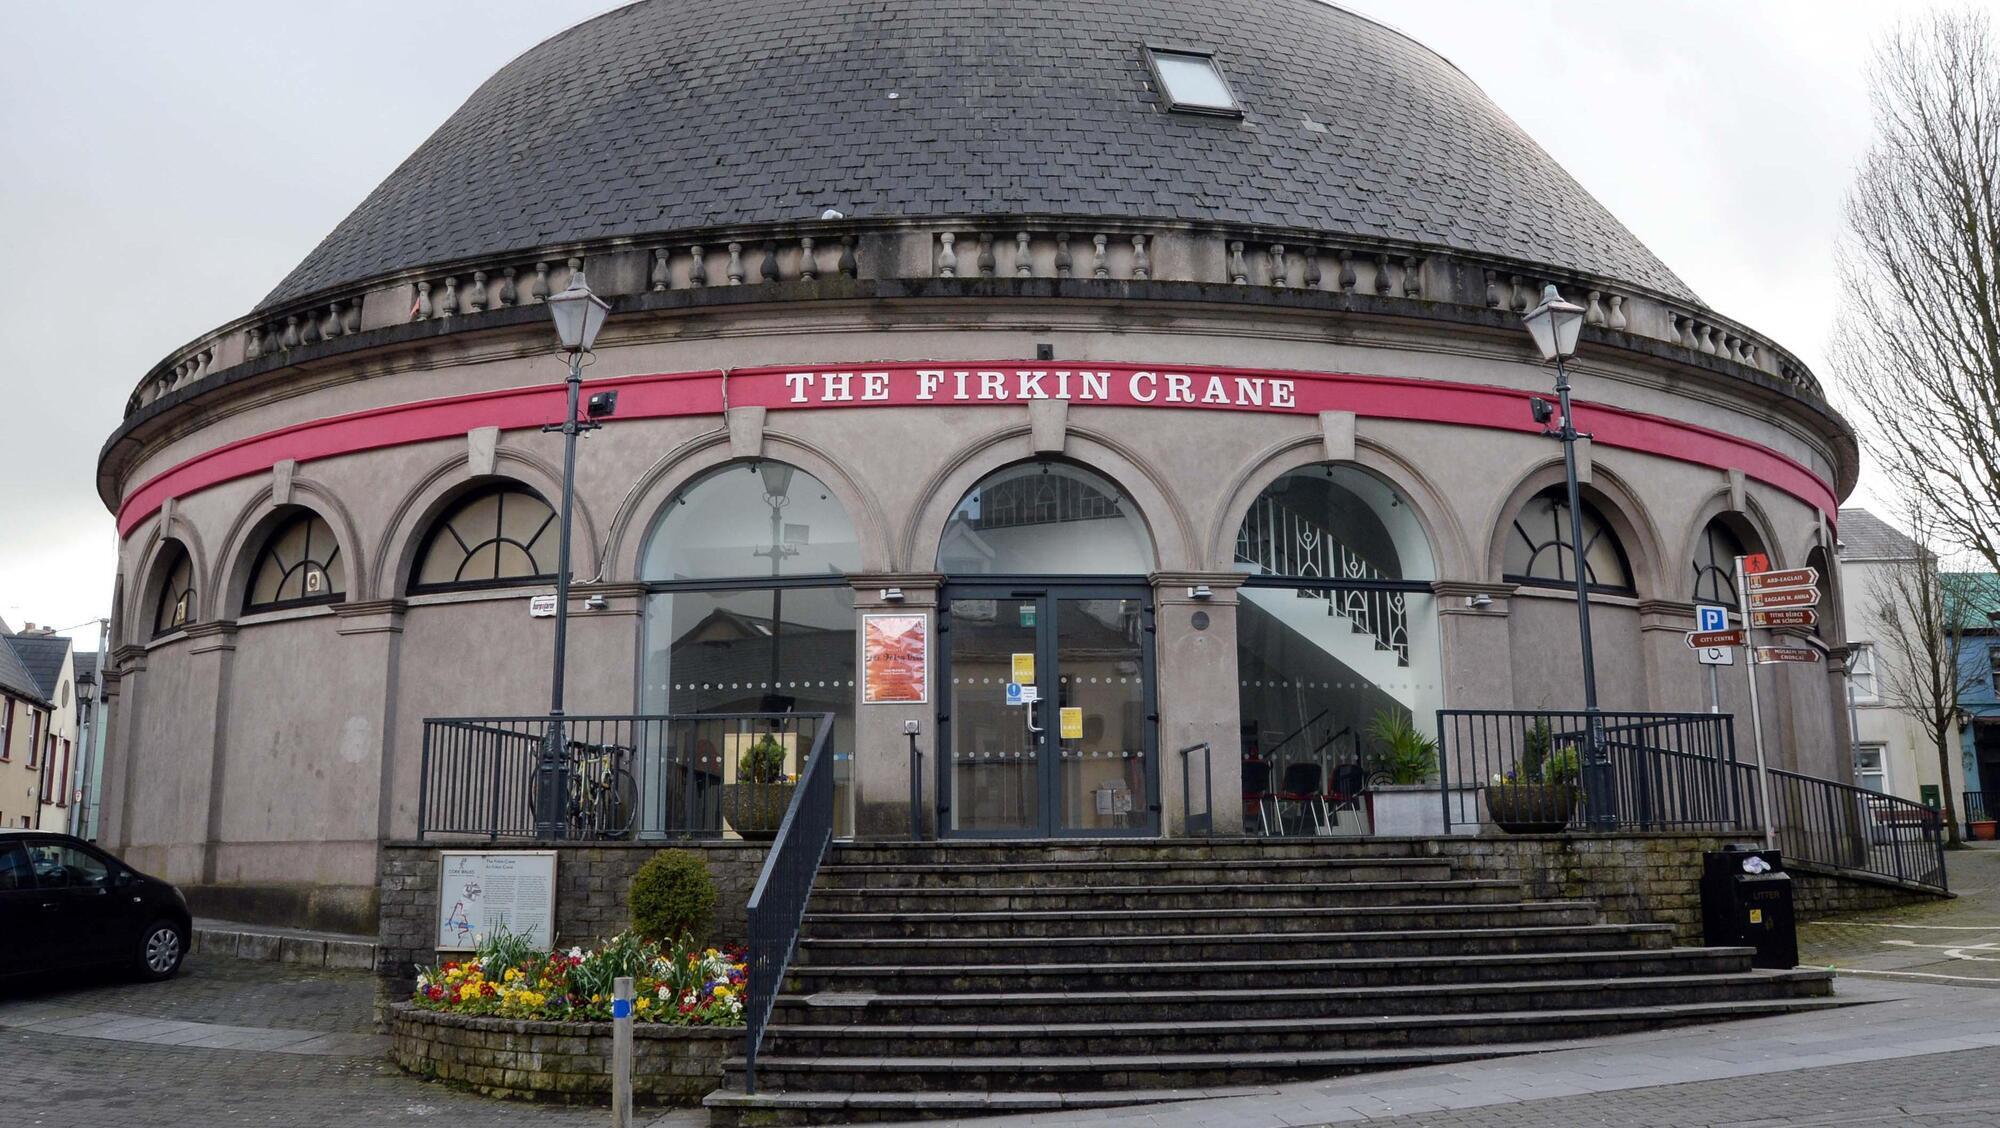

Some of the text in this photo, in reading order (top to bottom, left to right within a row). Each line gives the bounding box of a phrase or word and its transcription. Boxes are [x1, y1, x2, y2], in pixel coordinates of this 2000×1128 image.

[785, 370, 1296, 408] THE FIRKIN CRANE
[1706, 611, 1719, 630] P
